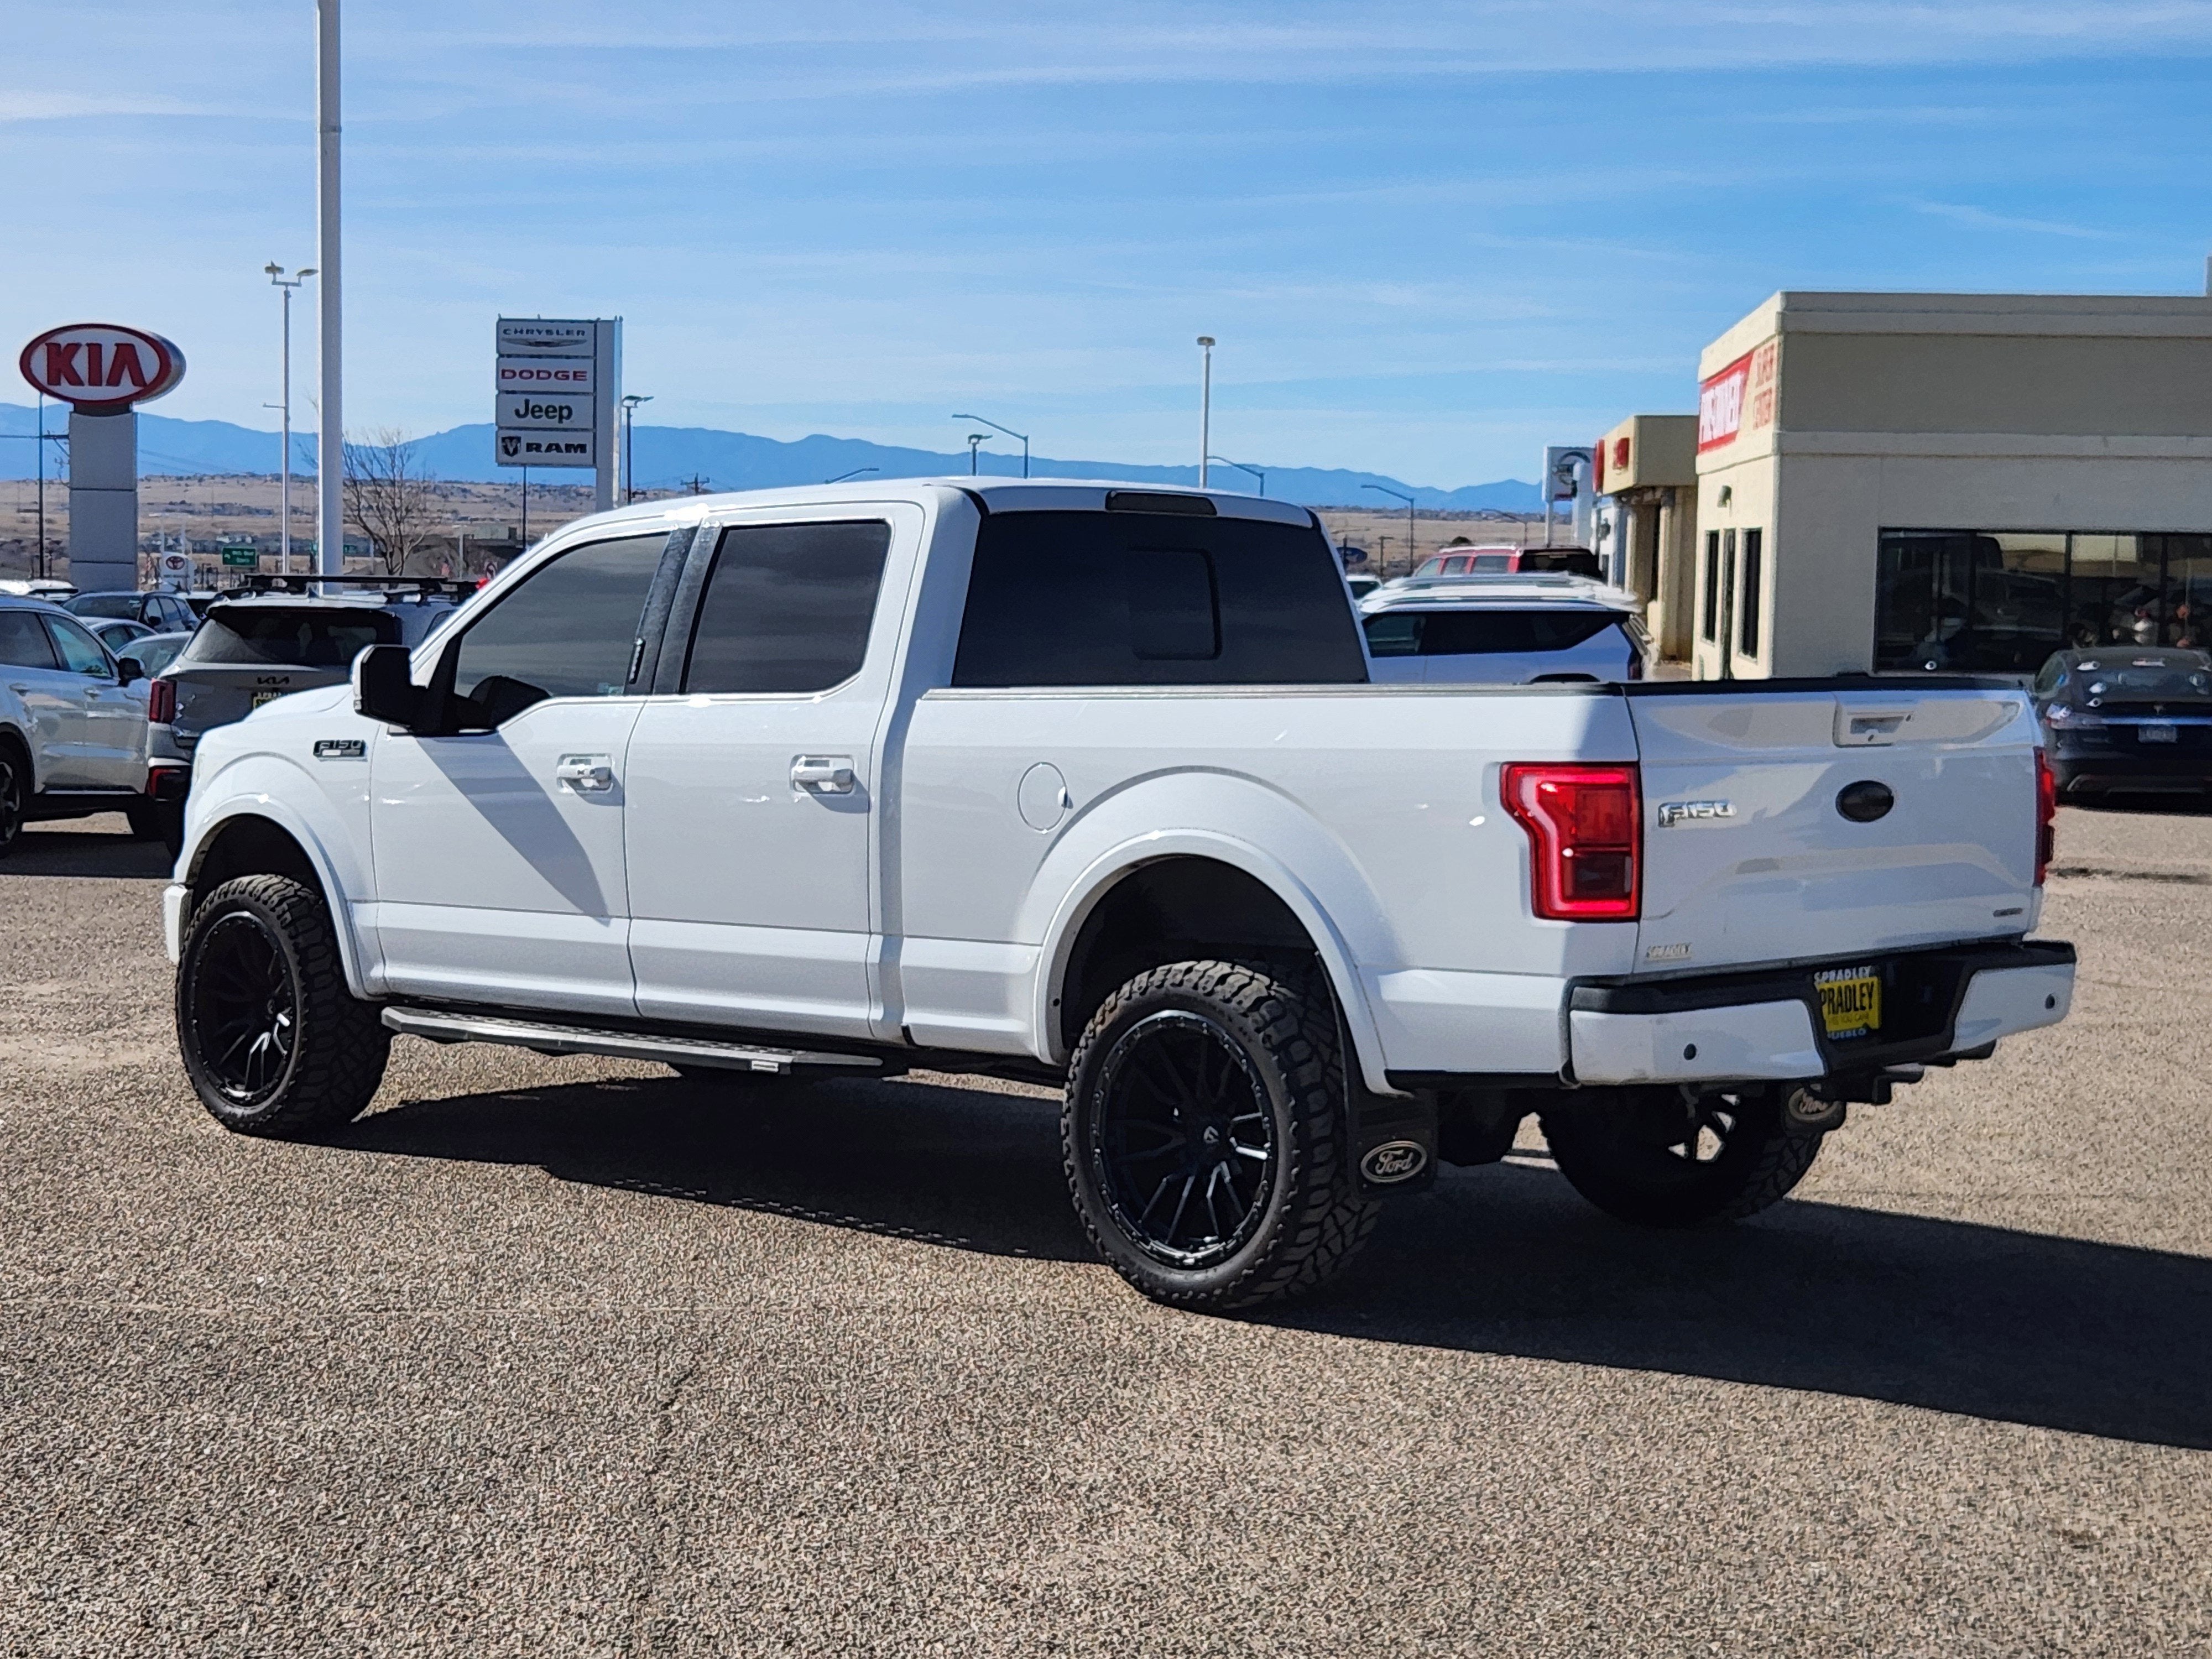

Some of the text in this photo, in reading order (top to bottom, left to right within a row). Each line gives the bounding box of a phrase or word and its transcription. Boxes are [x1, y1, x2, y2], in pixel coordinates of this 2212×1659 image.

[502, 327, 586, 336] CHRYSLER
[45, 342, 148, 387] KIA
[501, 368, 588, 382] DODGE
[514, 398, 573, 424] Jeep
[525, 442, 587, 454] RAM
[1814, 965, 1872, 983] SPRADLEY
[1819, 980, 1875, 1015] PRADLEY
[1375, 1149, 1413, 1174] Ford
